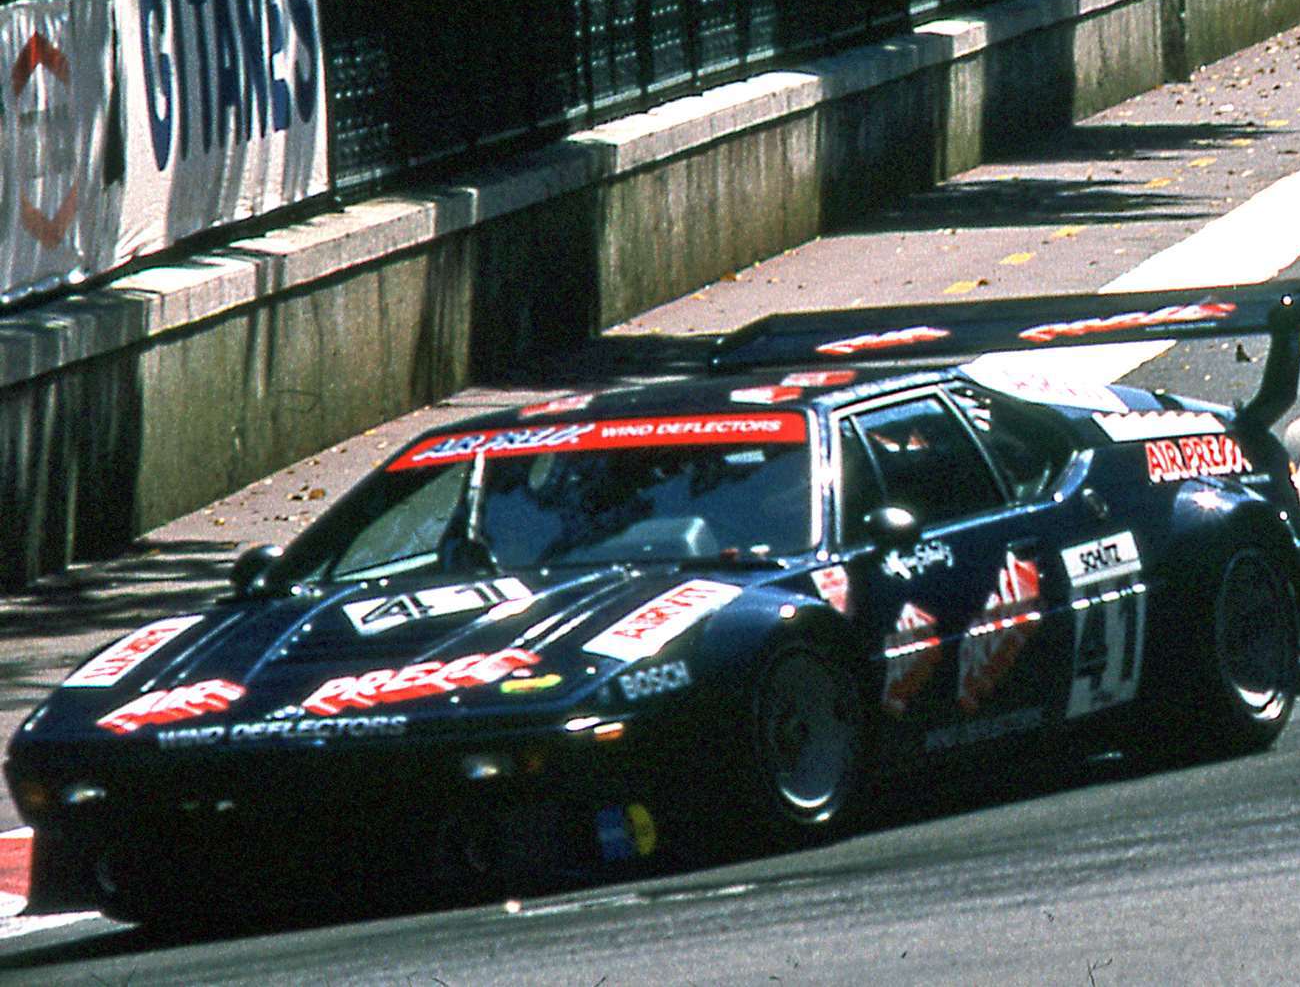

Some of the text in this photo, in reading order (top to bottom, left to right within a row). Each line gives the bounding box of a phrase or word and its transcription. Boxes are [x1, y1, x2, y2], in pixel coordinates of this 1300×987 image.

[601, 422, 653, 437] WIND
[656, 419, 782, 436] DEFLECTORS
[618, 660, 690, 700] BOSCH
[229, 715, 407, 742] DEFLECTORS
